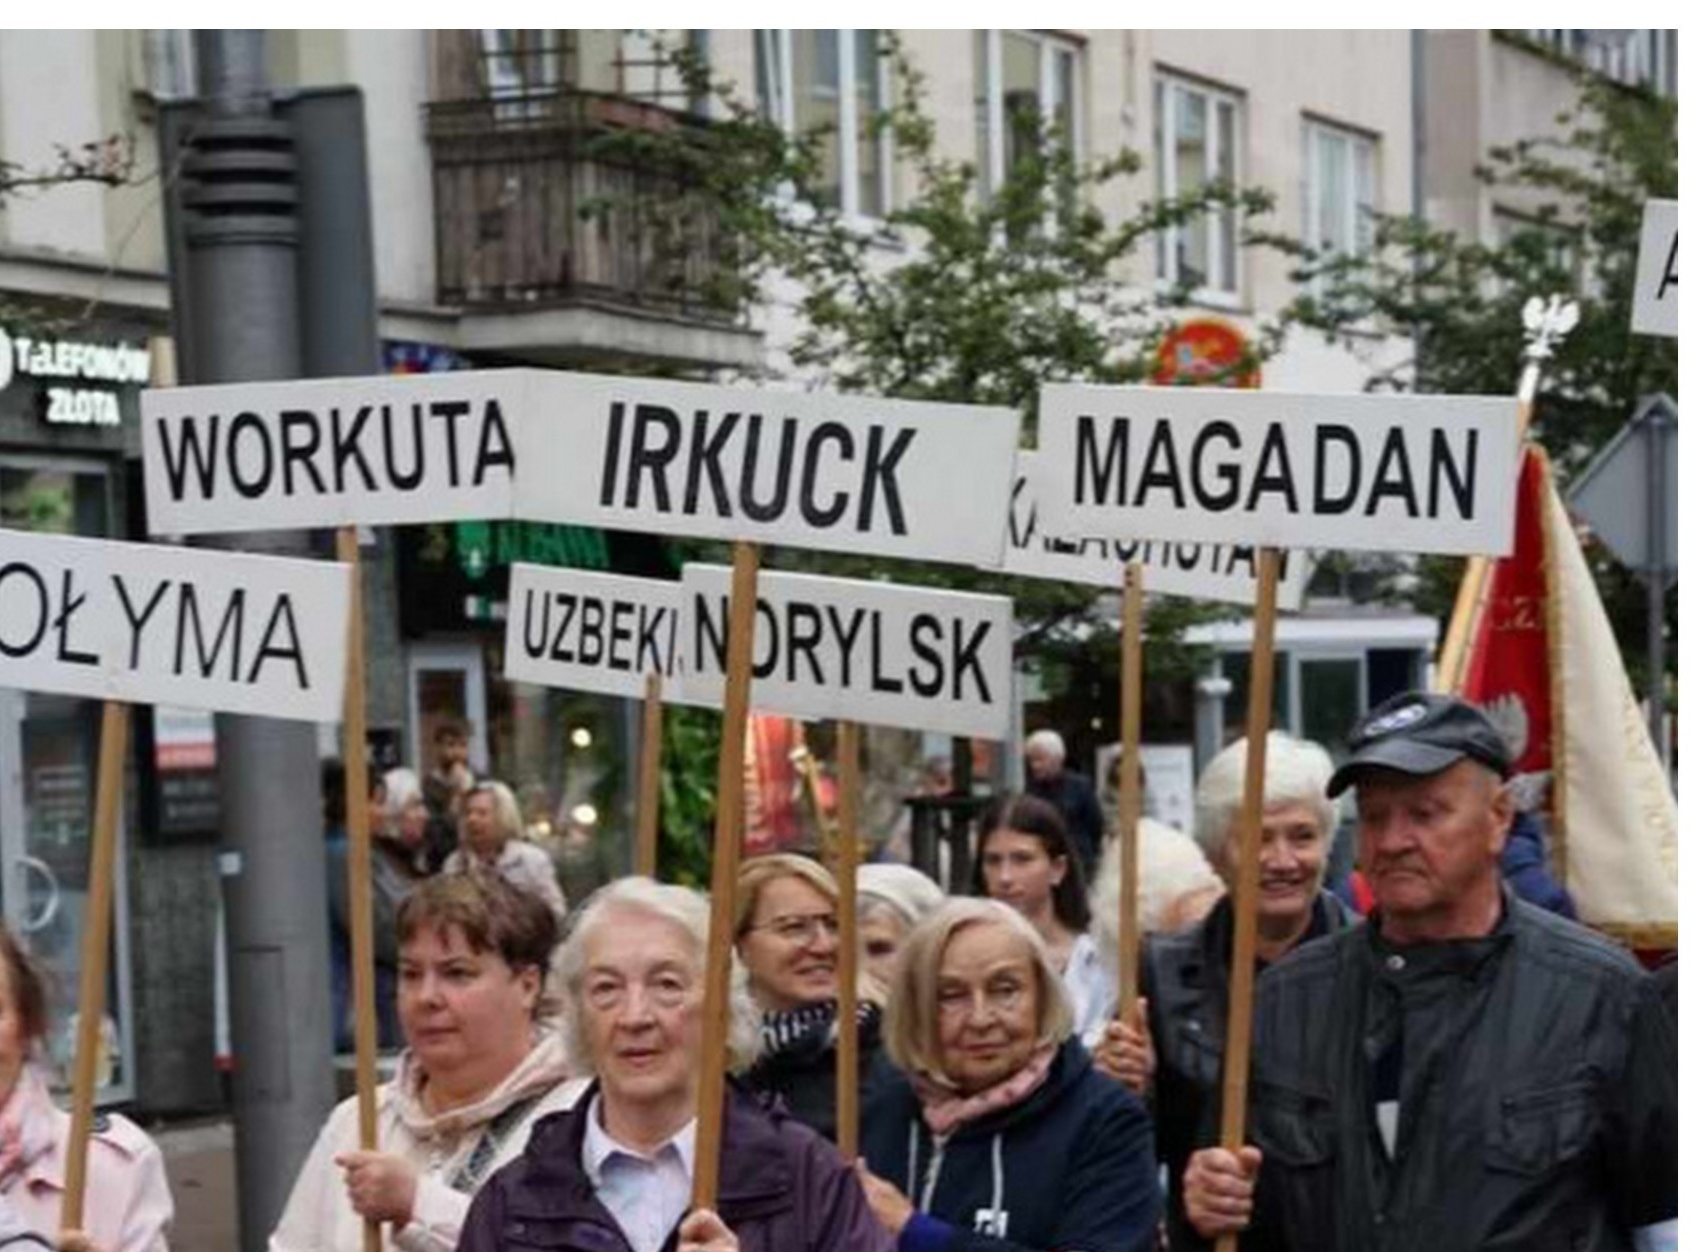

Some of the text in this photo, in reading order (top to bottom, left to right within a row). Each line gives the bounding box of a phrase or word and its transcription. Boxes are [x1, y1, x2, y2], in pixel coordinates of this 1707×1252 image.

[157, 398, 516, 501] WORKUTA
[600, 401, 917, 535] IRKUCK
[1074, 415, 1479, 521] MAGADAN
[523, 589, 684, 677] UZBEKI
[695, 592, 993, 704] NORYLSK
